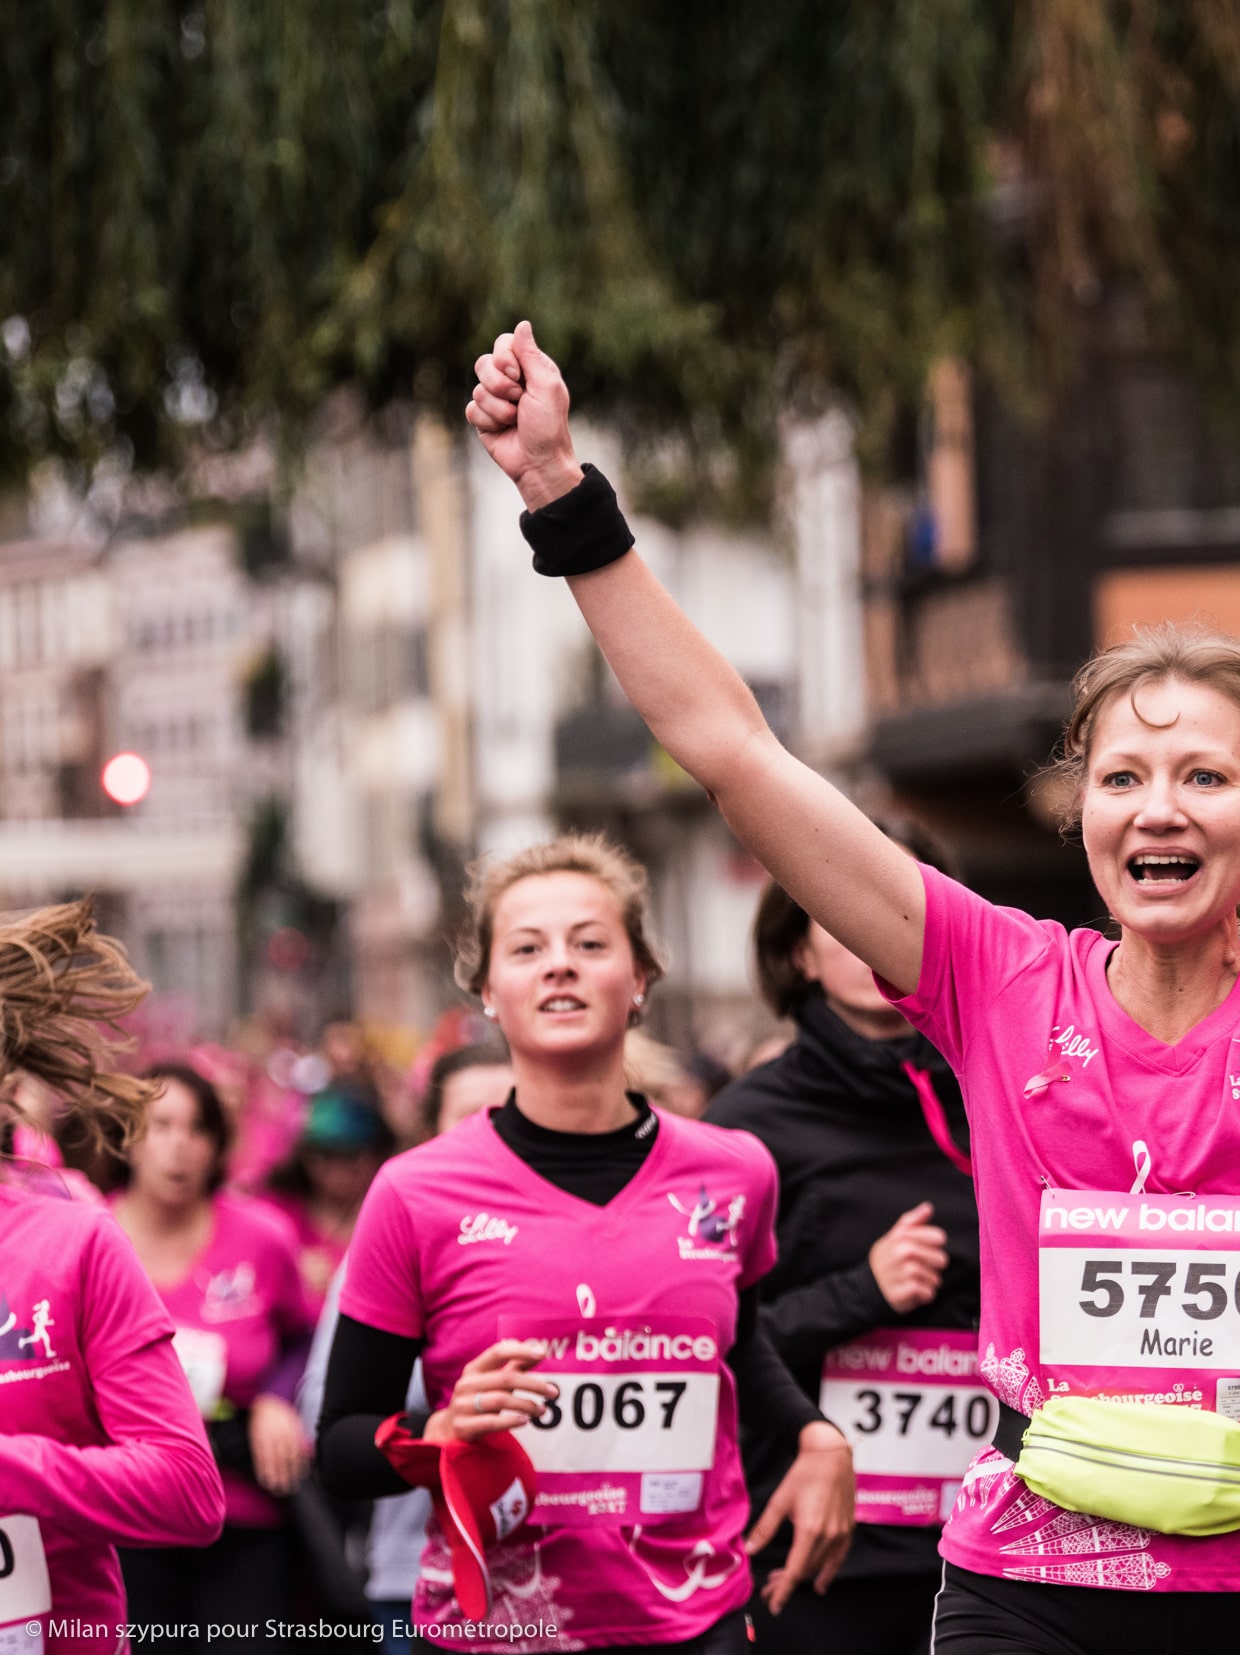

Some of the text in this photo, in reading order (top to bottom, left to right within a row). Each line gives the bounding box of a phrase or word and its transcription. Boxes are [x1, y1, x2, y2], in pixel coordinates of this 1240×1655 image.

[457, 1213, 519, 1245] Lilly
[1045, 1206, 1129, 1229] new
[575, 1330, 718, 1361] balance
[1140, 1328, 1213, 1356] Marie
[1047, 1378, 1069, 1392] La
[857, 1389, 990, 1438] 3740
